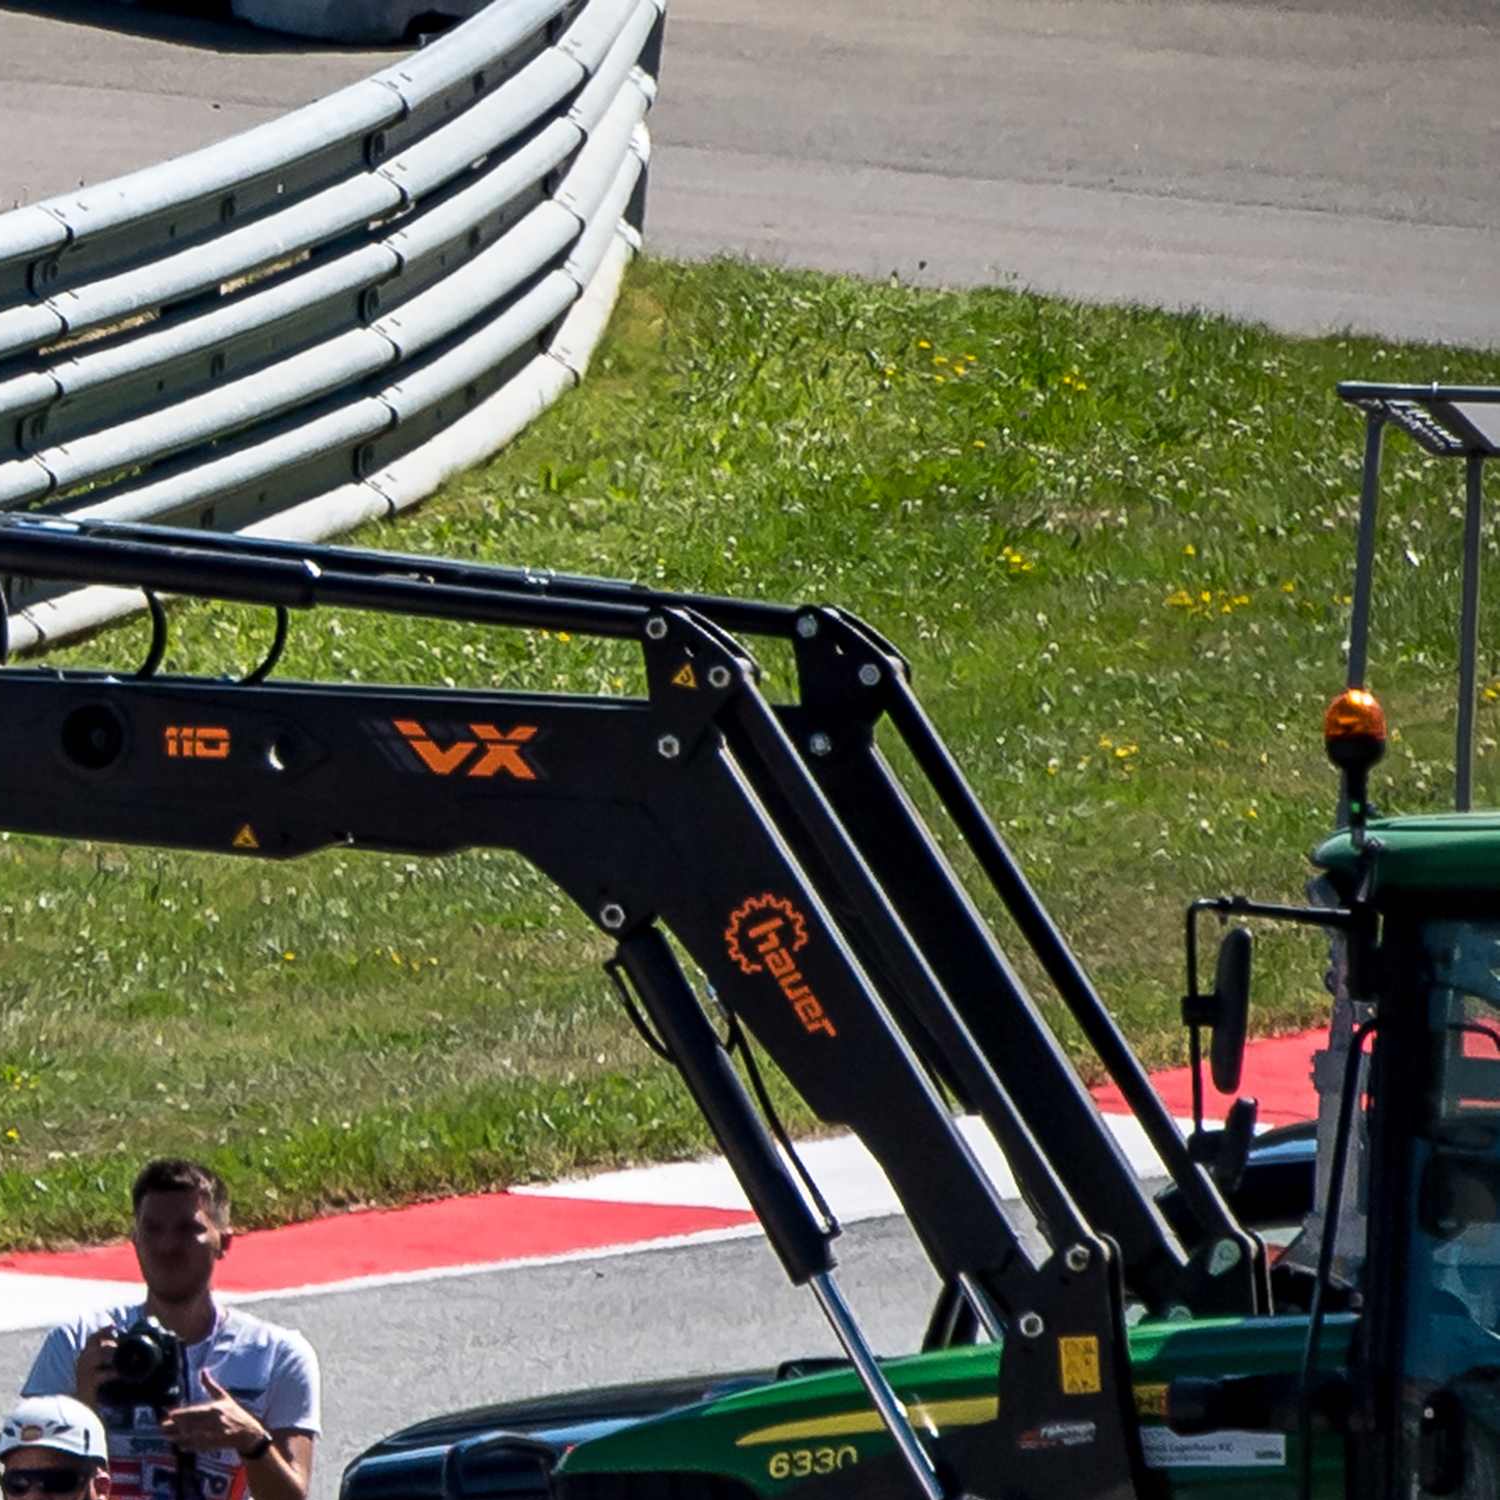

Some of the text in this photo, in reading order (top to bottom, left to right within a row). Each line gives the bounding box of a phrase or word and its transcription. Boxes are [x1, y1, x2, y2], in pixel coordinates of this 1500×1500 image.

[164, 718, 540, 780] 110 VX
[747, 916, 838, 1038] hauer
[769, 1444, 859, 1479] 6330
